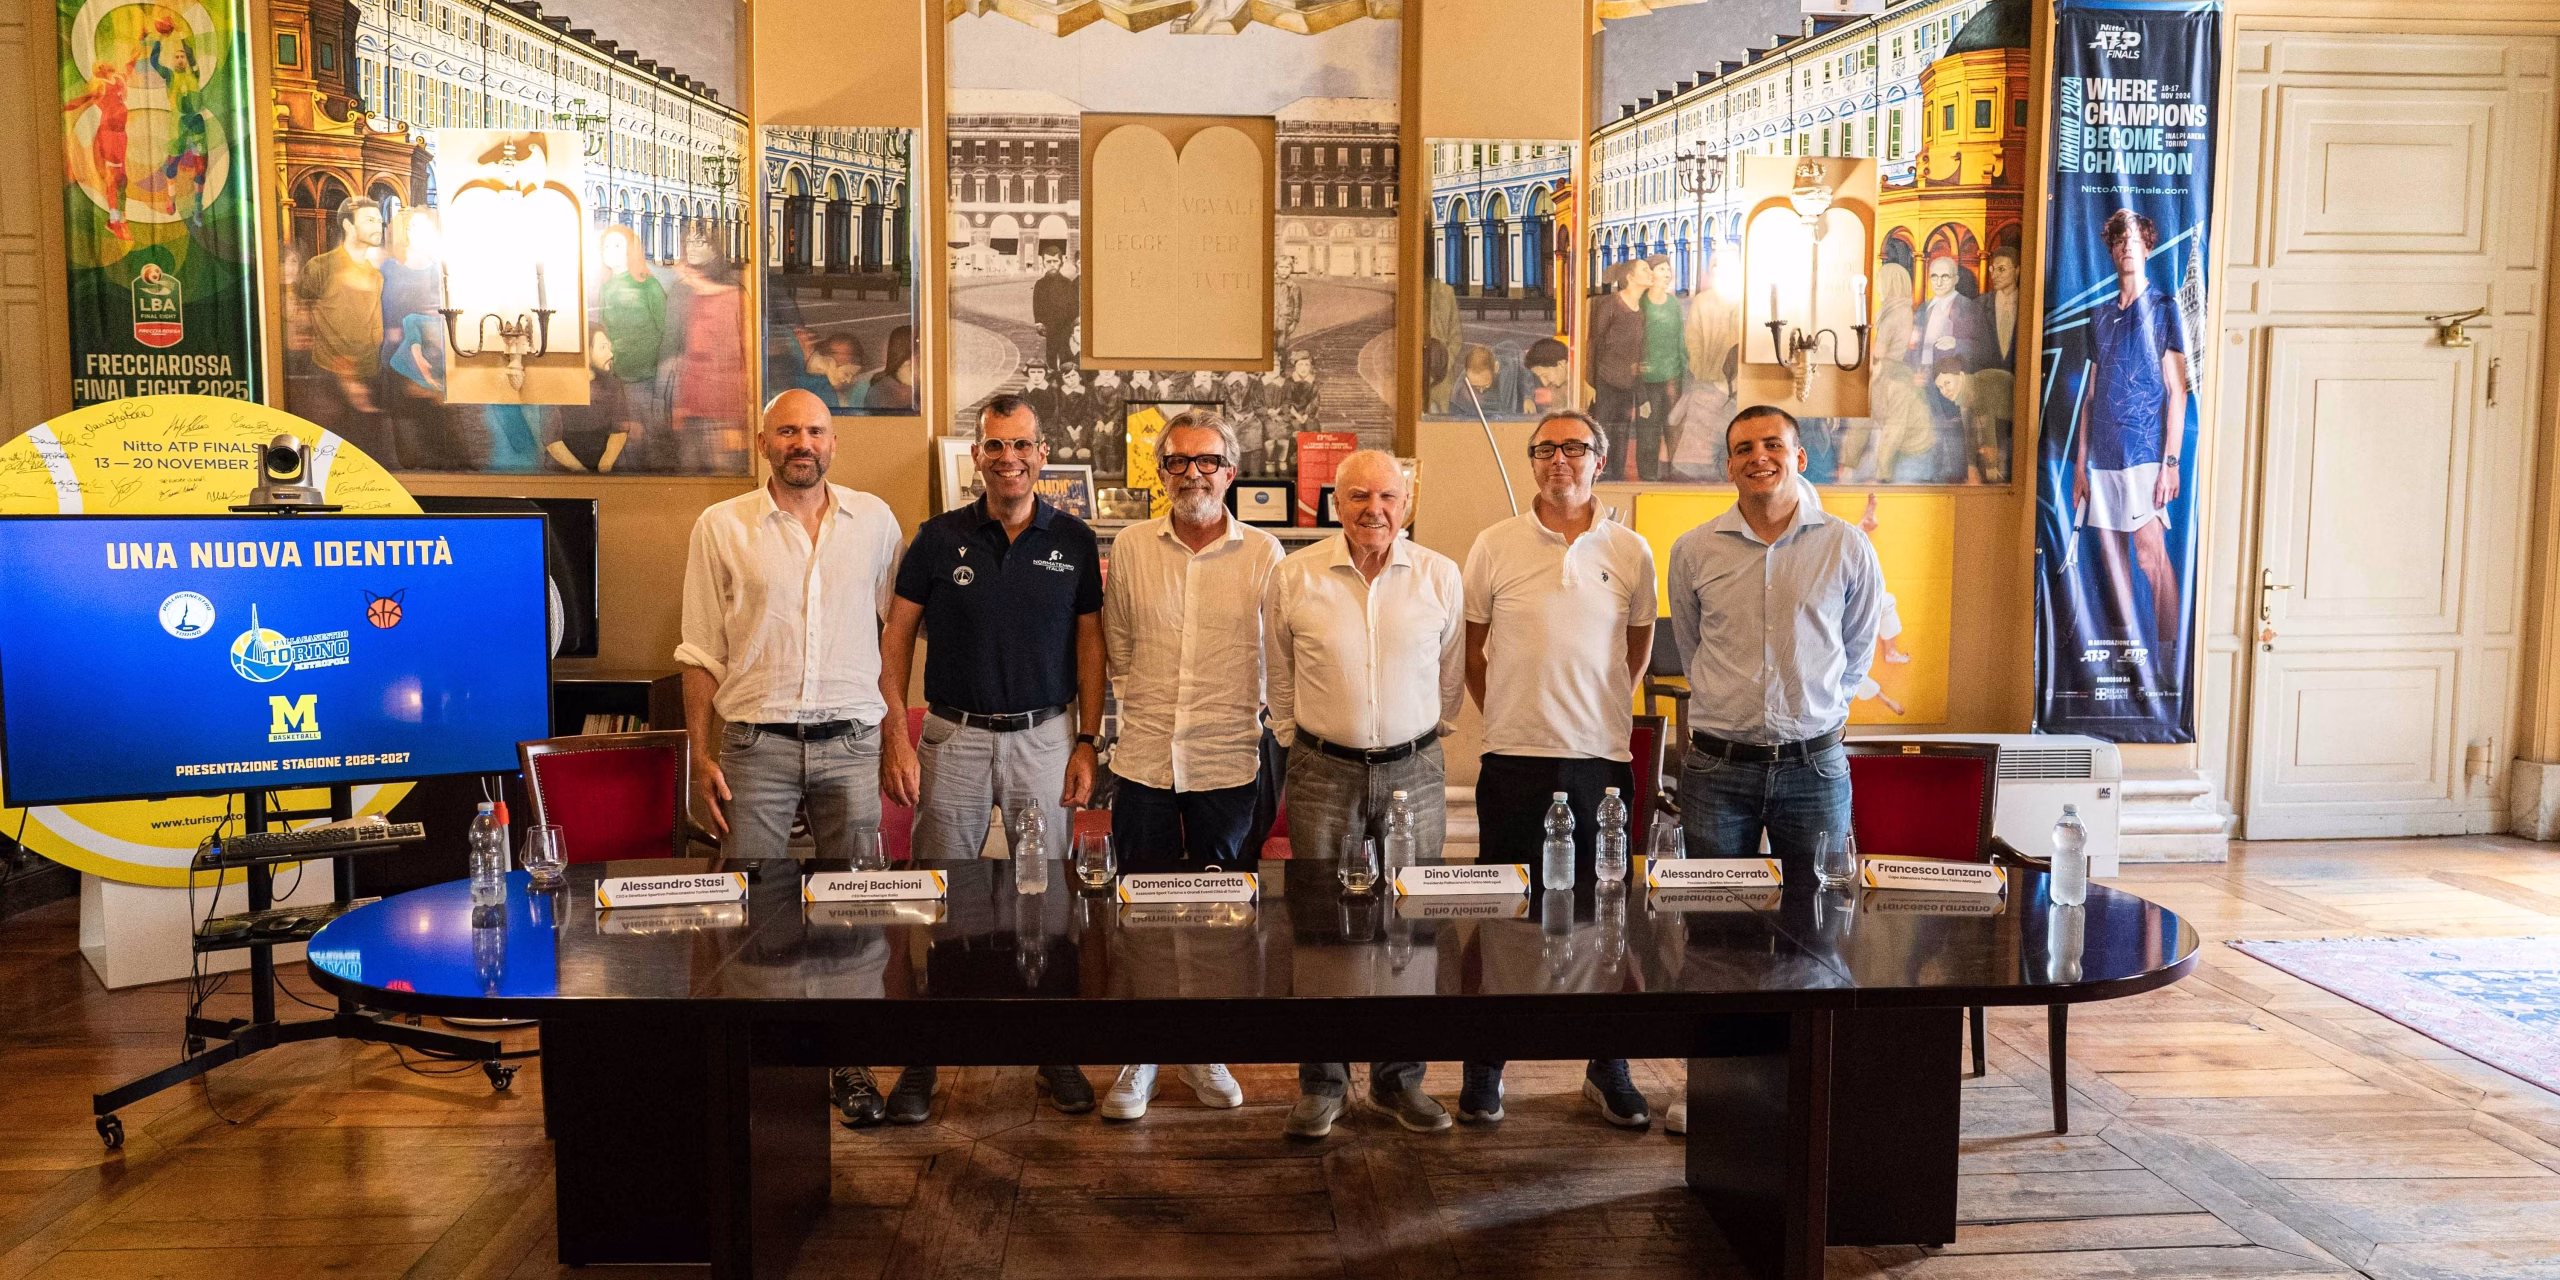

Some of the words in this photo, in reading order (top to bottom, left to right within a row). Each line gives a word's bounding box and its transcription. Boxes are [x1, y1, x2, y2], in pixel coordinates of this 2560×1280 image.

[2100, 23, 2125, 32] Nitto
[2087, 31, 2142, 50] ATP
[2106, 50, 2140, 59] FINALS
[2086, 77, 2158, 102] WHERE
[2161, 84, 2179, 92] 10-17
[2061, 77, 2082, 115] 2024
[2084, 102, 2208, 127] CHAMPIONS
[2058, 115, 2080, 172] TORINO
[2083, 127, 2164, 150] BECOME
[2165, 132, 2186, 140] INALPI
[2187, 132, 2206, 140] ARENA
[2083, 151, 2193, 175] CHAMPION
[2081, 185, 2189, 195] NittoATPFinals.com
[1123, 196, 1149, 213] LA
[1202, 234, 1240, 253] PER
[140, 298, 177, 312] LBA
[86, 354, 233, 376] FRECCIAROSSA
[74, 379, 127, 400] FINAL
[136, 379, 192, 396] EIGHT
[197, 380, 249, 400] 2025
[123, 440, 163, 452] Nitto
[168, 441, 199, 453] ATP
[204, 442, 259, 454] FINALS
[94, 457, 110, 468] 13
[133, 457, 153, 469] 20
[157, 458, 249, 470] NOVEMBER
[106, 541, 178, 570] UNA
[191, 540, 302, 569] NUOVA
[314, 535, 453, 567] IDENTITÀ
[162, 593, 212, 612] PALLACANESTRO
[175, 629, 202, 638] TORINO
[263, 638, 350, 667] TORINO
[2080, 650, 2110, 662] ATP
[294, 656, 350, 671] METROPOLI
[268, 694, 319, 734] M
[273, 733, 318, 741] BASKETBALL
[176, 759, 279, 777] PRESENTAZIONE
[282, 755, 342, 771] STAGIONE
[345, 751, 411, 767] 2026-2027
[1424, 868, 1450, 879] Dino
[1452, 868, 1499, 878] Violante
[1660, 869, 1724, 879] Alessandro
[1726, 870, 1769, 879] Cerrato
[1878, 863, 1939, 875] Francesco
[1942, 867, 1992, 877] Lanzano
[620, 878, 692, 892] Alessandro
[694, 876, 725, 888] Stasi
[828, 880, 868, 893] Andrej
[870, 879, 922, 890] Bachioni
[1132, 877, 1192, 889] Domenico
[1194, 877, 1243, 888] Carretta
